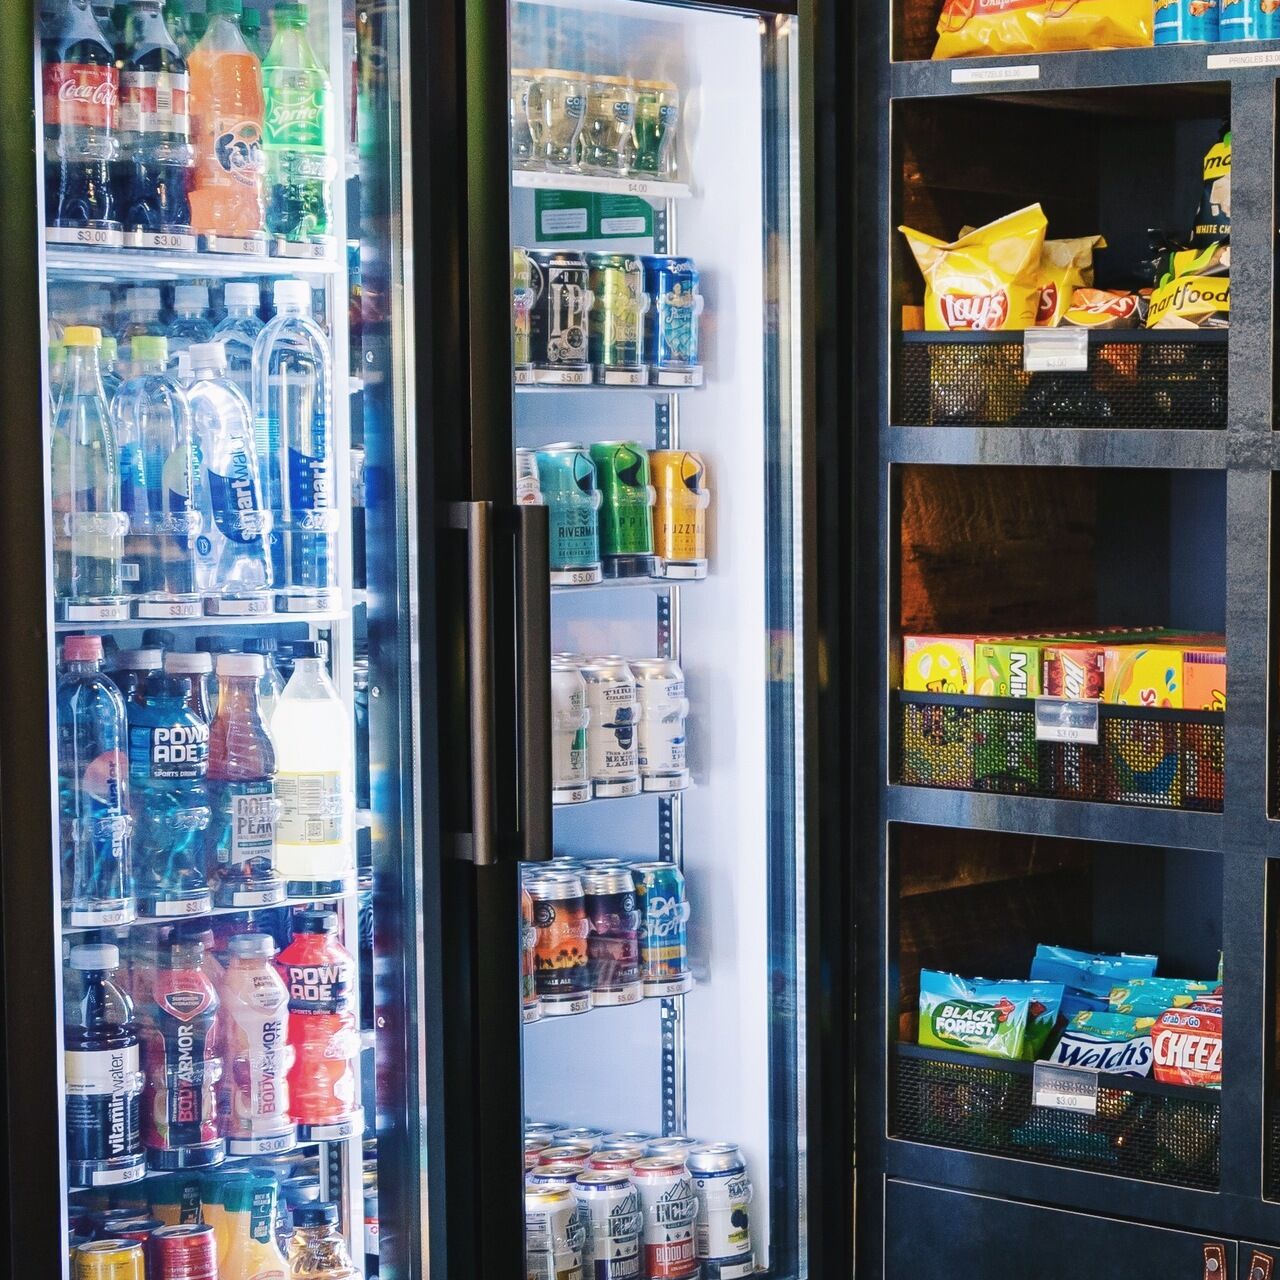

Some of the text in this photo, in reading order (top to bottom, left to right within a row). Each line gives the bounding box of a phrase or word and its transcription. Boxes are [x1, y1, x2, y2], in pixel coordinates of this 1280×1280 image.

[1229, 56, 1264, 64] PRINGLES
[58, 80, 118, 106] Coca-Cola
[270, 106, 317, 124] Sprite
[629, 184, 647, 193] $4.00
[1195, 224, 1217, 234] WHITE
[77, 231, 107, 242] $3.00
[1147, 282, 1230, 320] martfood
[941, 288, 1005, 330] Lay's
[561, 372, 583, 382] $5.00
[572, 572, 594, 582] $5.00
[153, 745, 198, 763] ADE
[154, 770, 179, 778] SPORTS
[941, 1005, 996, 1022] BLACK
[935, 1017, 997, 1035] FOREST
[1057, 1041, 1152, 1070] Welch's
[177, 1024, 193, 1123] BODYARMOR
[1055, 1097, 1077, 1106] $3.00
[258, 1140, 285, 1152] $3.00
